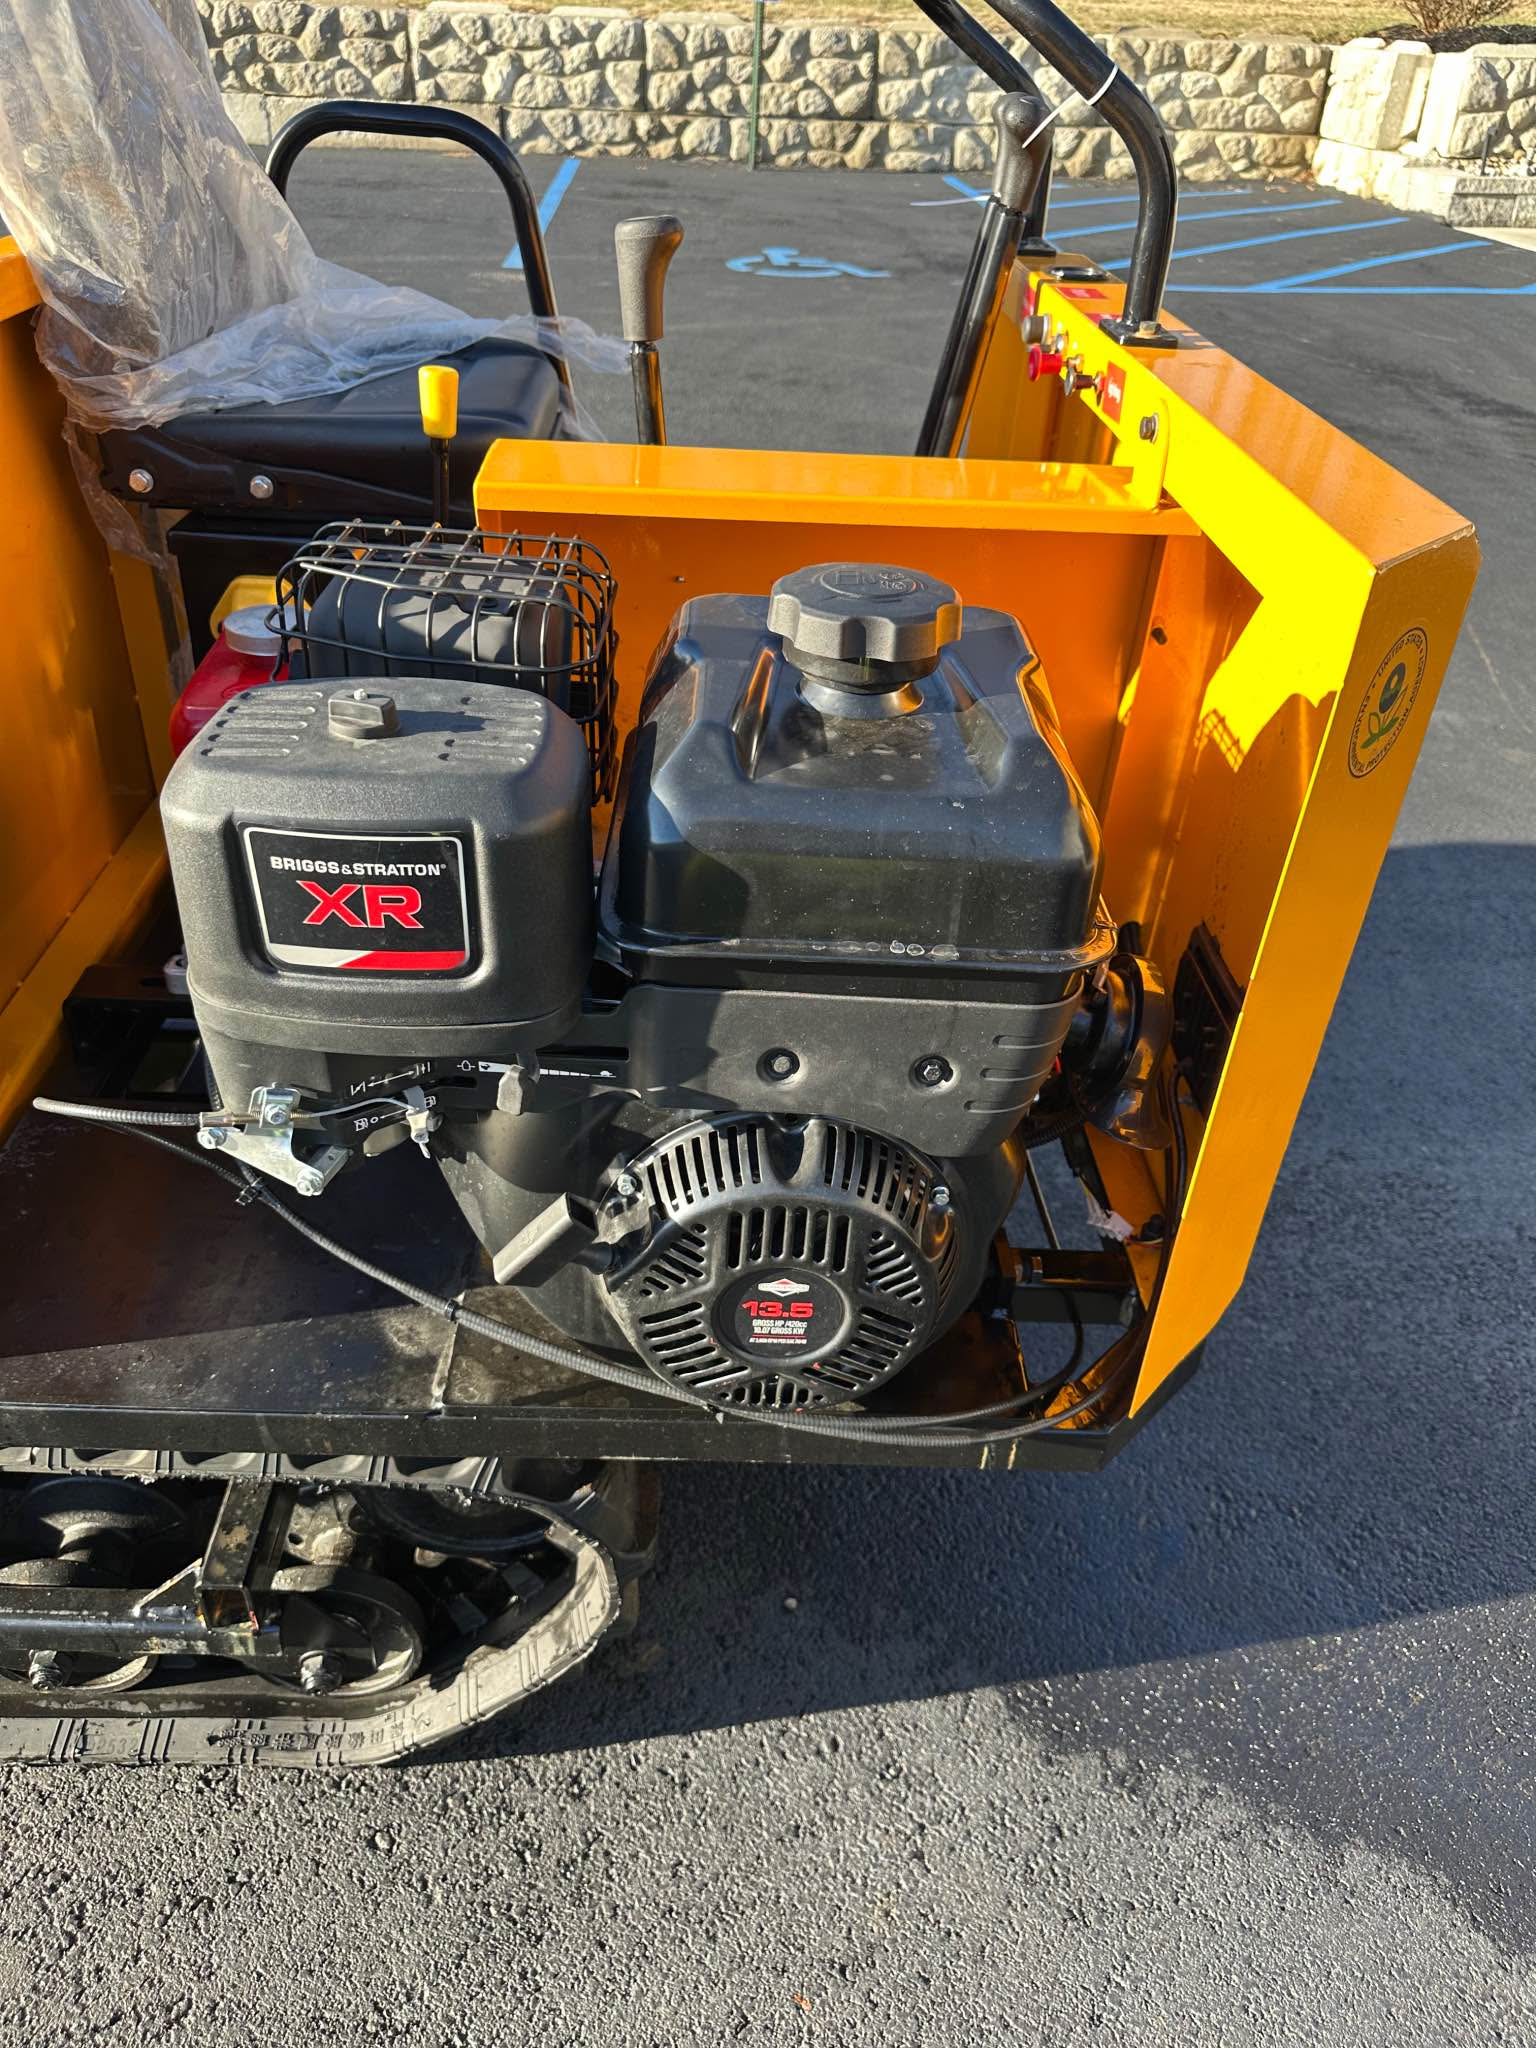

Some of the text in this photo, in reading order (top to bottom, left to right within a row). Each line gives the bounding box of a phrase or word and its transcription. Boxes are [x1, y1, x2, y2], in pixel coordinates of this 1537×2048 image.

[295, 880, 424, 929] XR
[741, 1300, 814, 1318] 13.5
[752, 1319, 775, 1327] GROSS
[771, 1327, 793, 1335] GROSS
